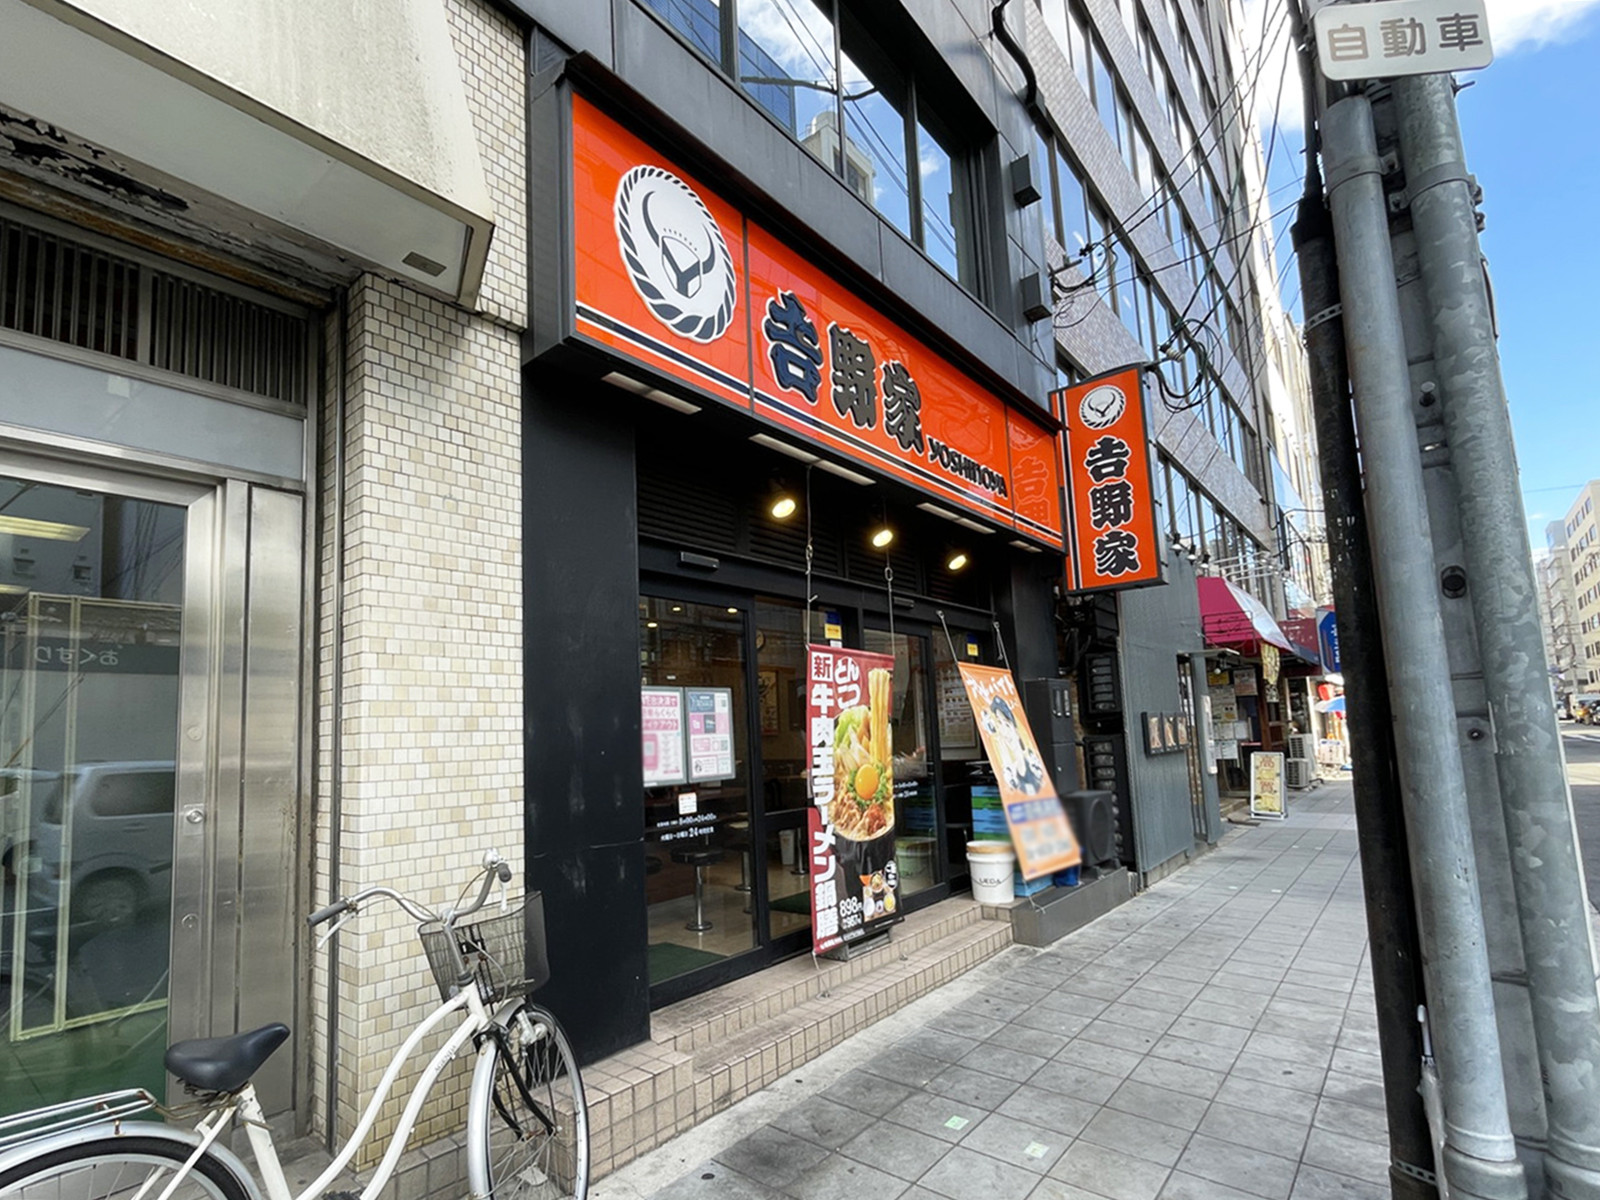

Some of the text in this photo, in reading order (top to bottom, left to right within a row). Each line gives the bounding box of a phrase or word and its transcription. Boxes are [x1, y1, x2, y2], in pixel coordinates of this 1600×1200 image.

[1327, 13, 1484, 61] 自動車
[762, 288, 925, 457] 吉野家
[926, 434, 1009, 500] YOSHINOYA
[1084, 435, 1141, 577] 吉野家
